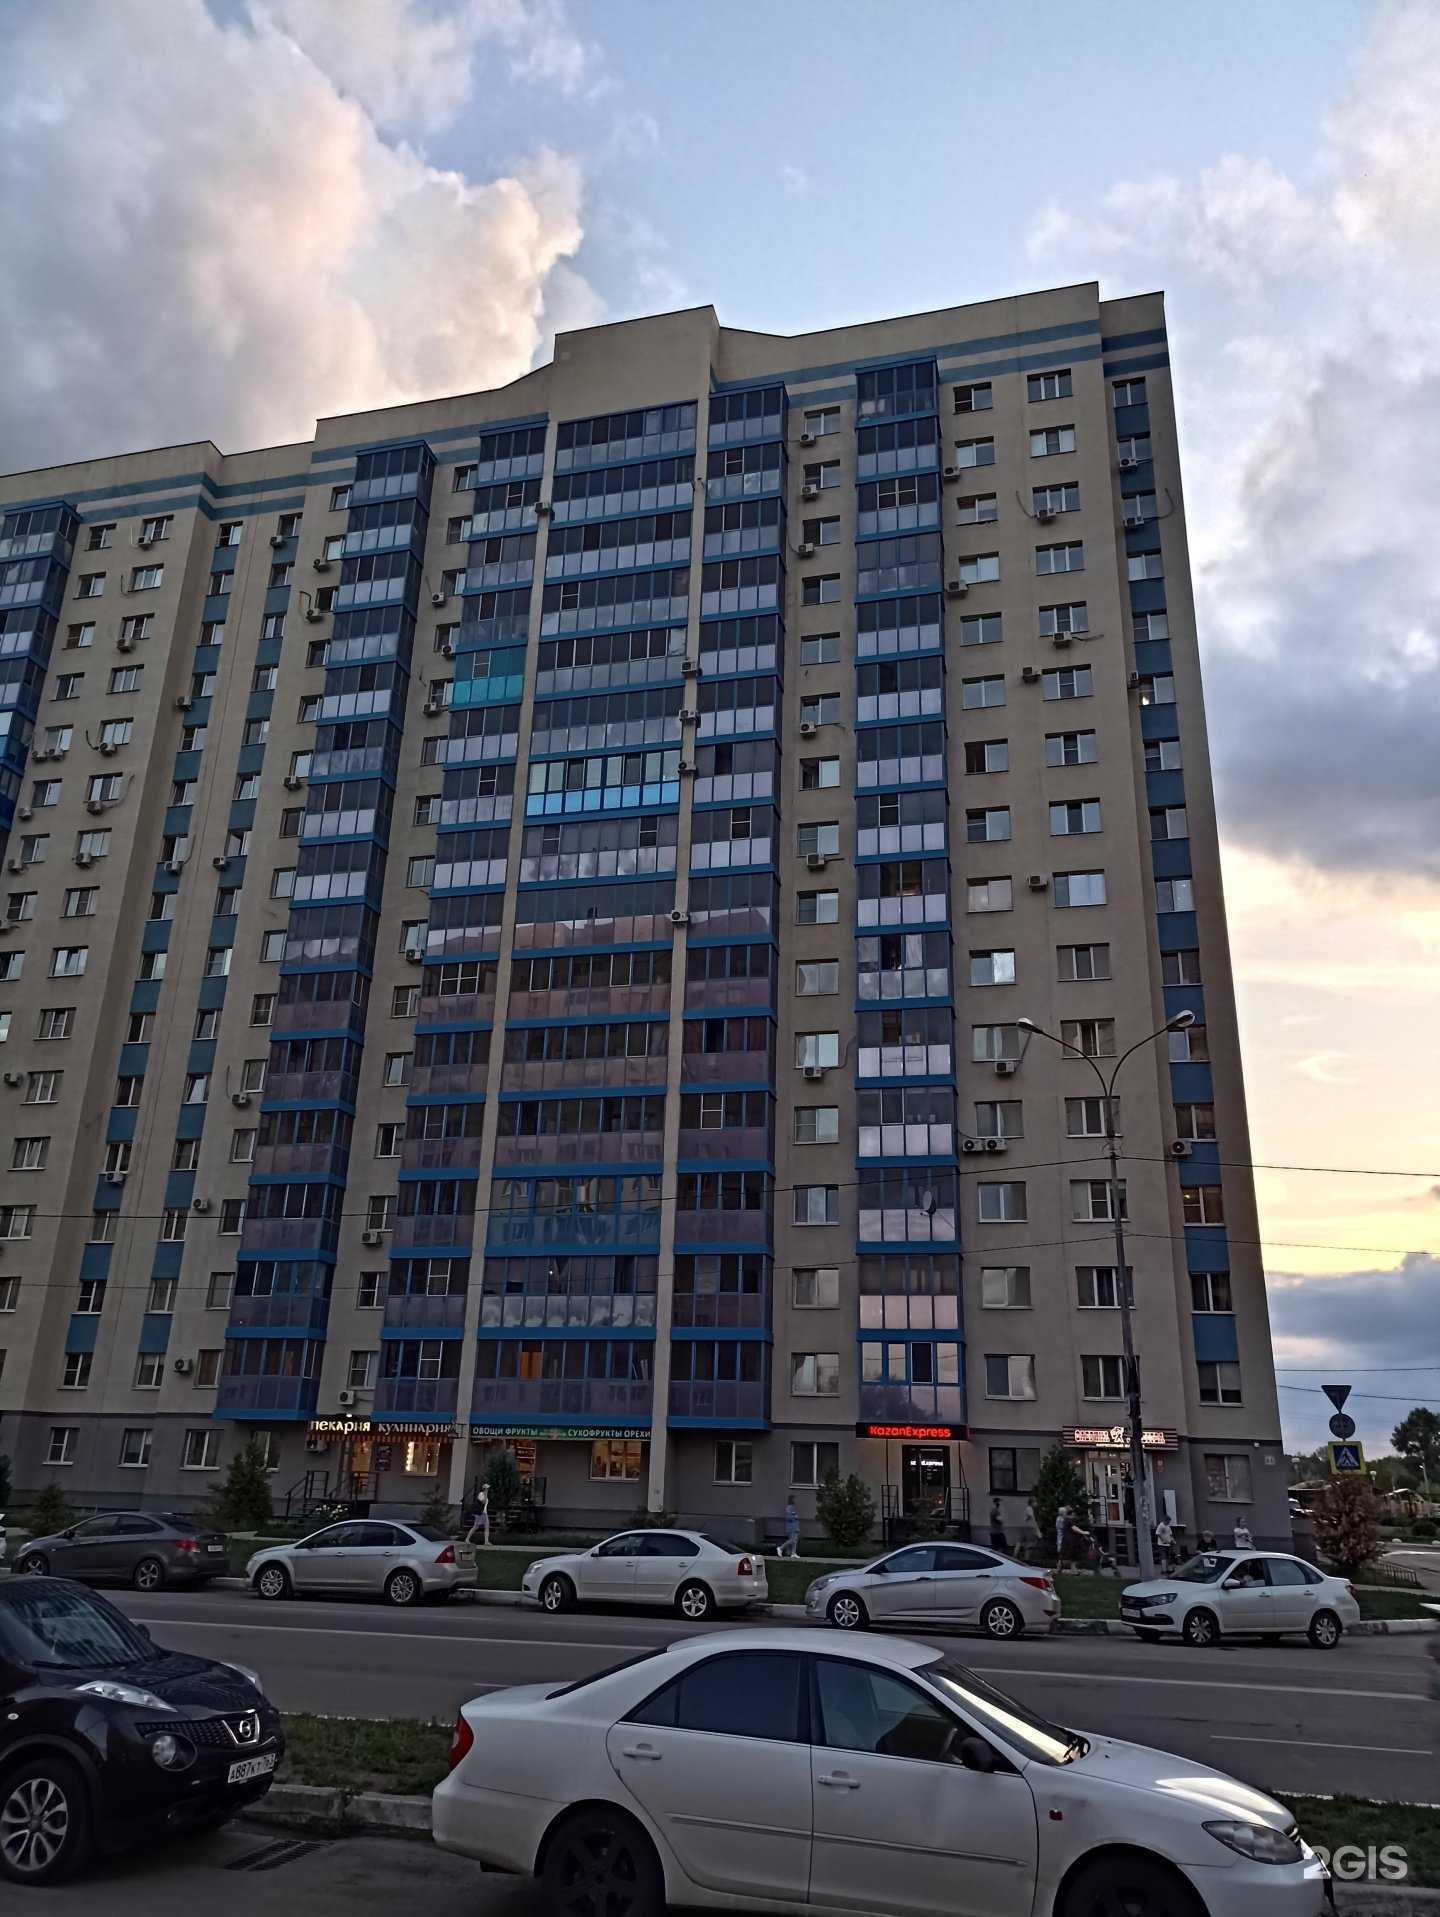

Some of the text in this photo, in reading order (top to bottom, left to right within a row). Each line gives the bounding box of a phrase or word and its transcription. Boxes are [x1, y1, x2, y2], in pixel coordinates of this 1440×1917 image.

[472, 1427, 504, 1436] ОВОЩИ
[505, 1427, 538, 1436] ФРУКТЫ
[567, 1429, 622, 1438] СУХОФРУКТЫ
[623, 1429, 651, 1438] ОРЕХИ
[869, 1425, 952, 1438] KazanExpress
